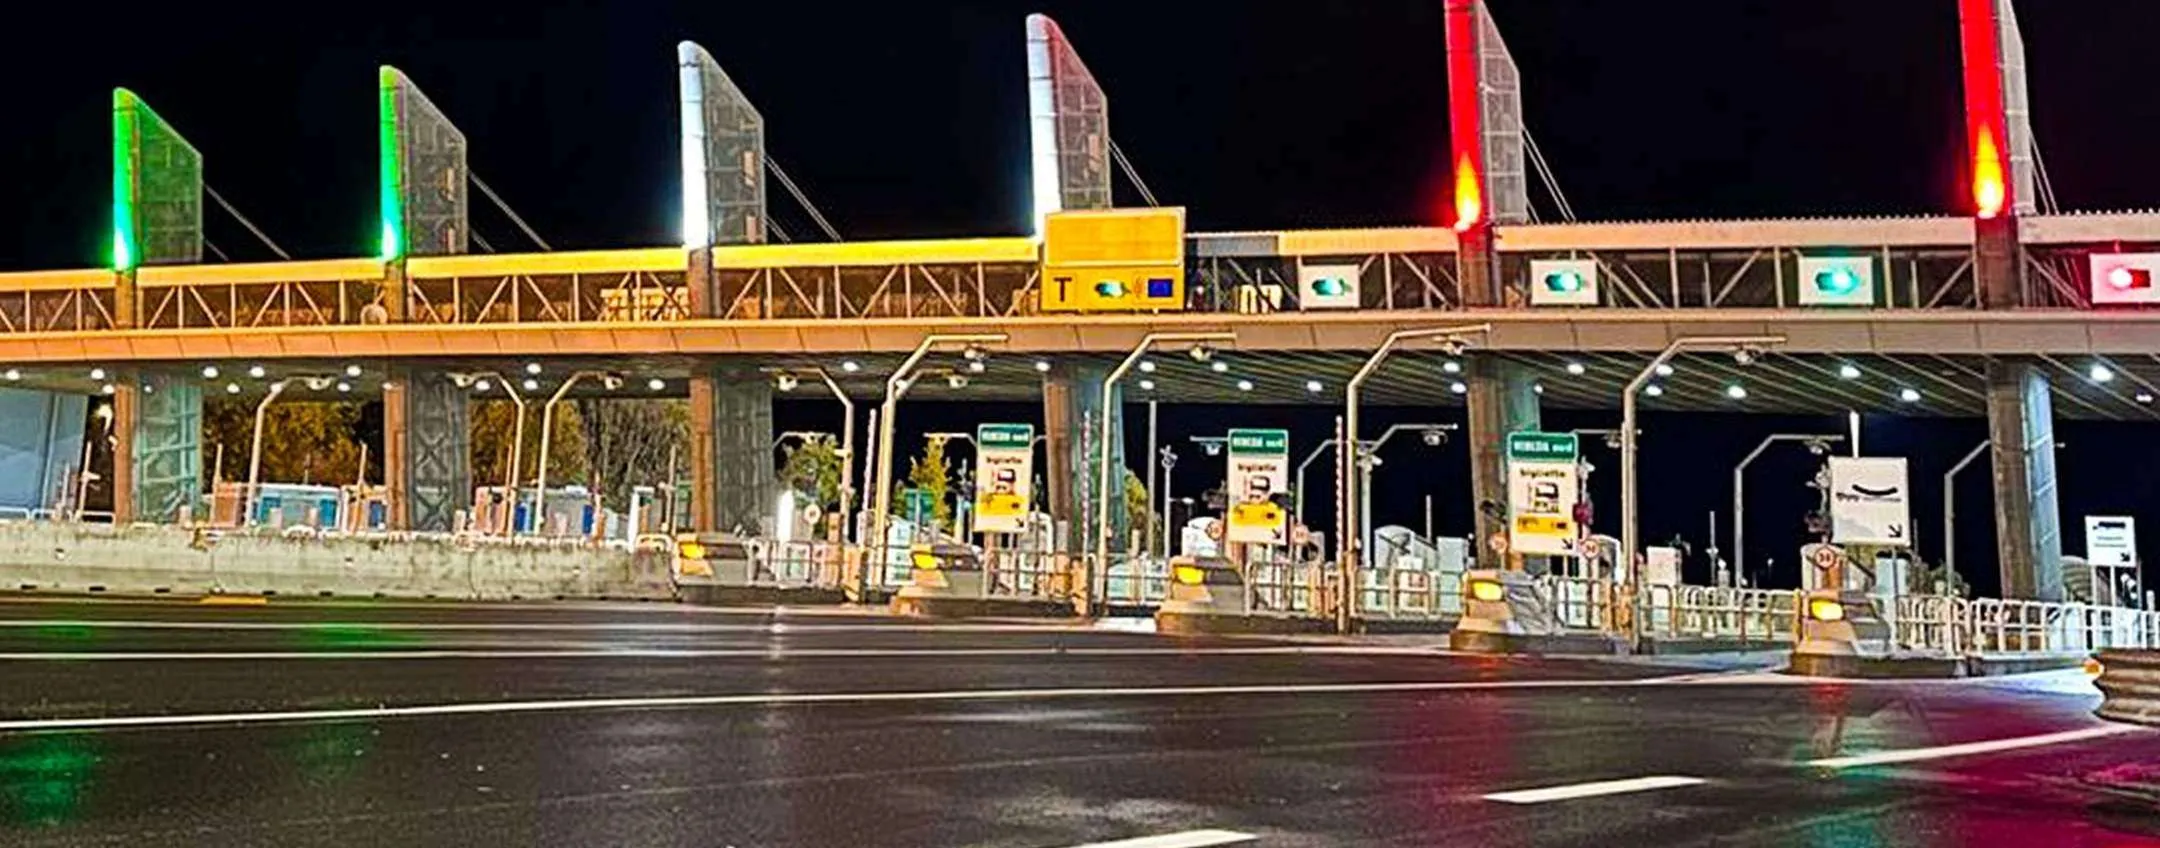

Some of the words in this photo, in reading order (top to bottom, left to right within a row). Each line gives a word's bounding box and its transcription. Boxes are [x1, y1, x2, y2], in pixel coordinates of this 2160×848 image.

[1053, 277, 1072, 302] T
[1237, 463, 1276, 473] biglietto
[1520, 468, 1566, 479] biglietto
